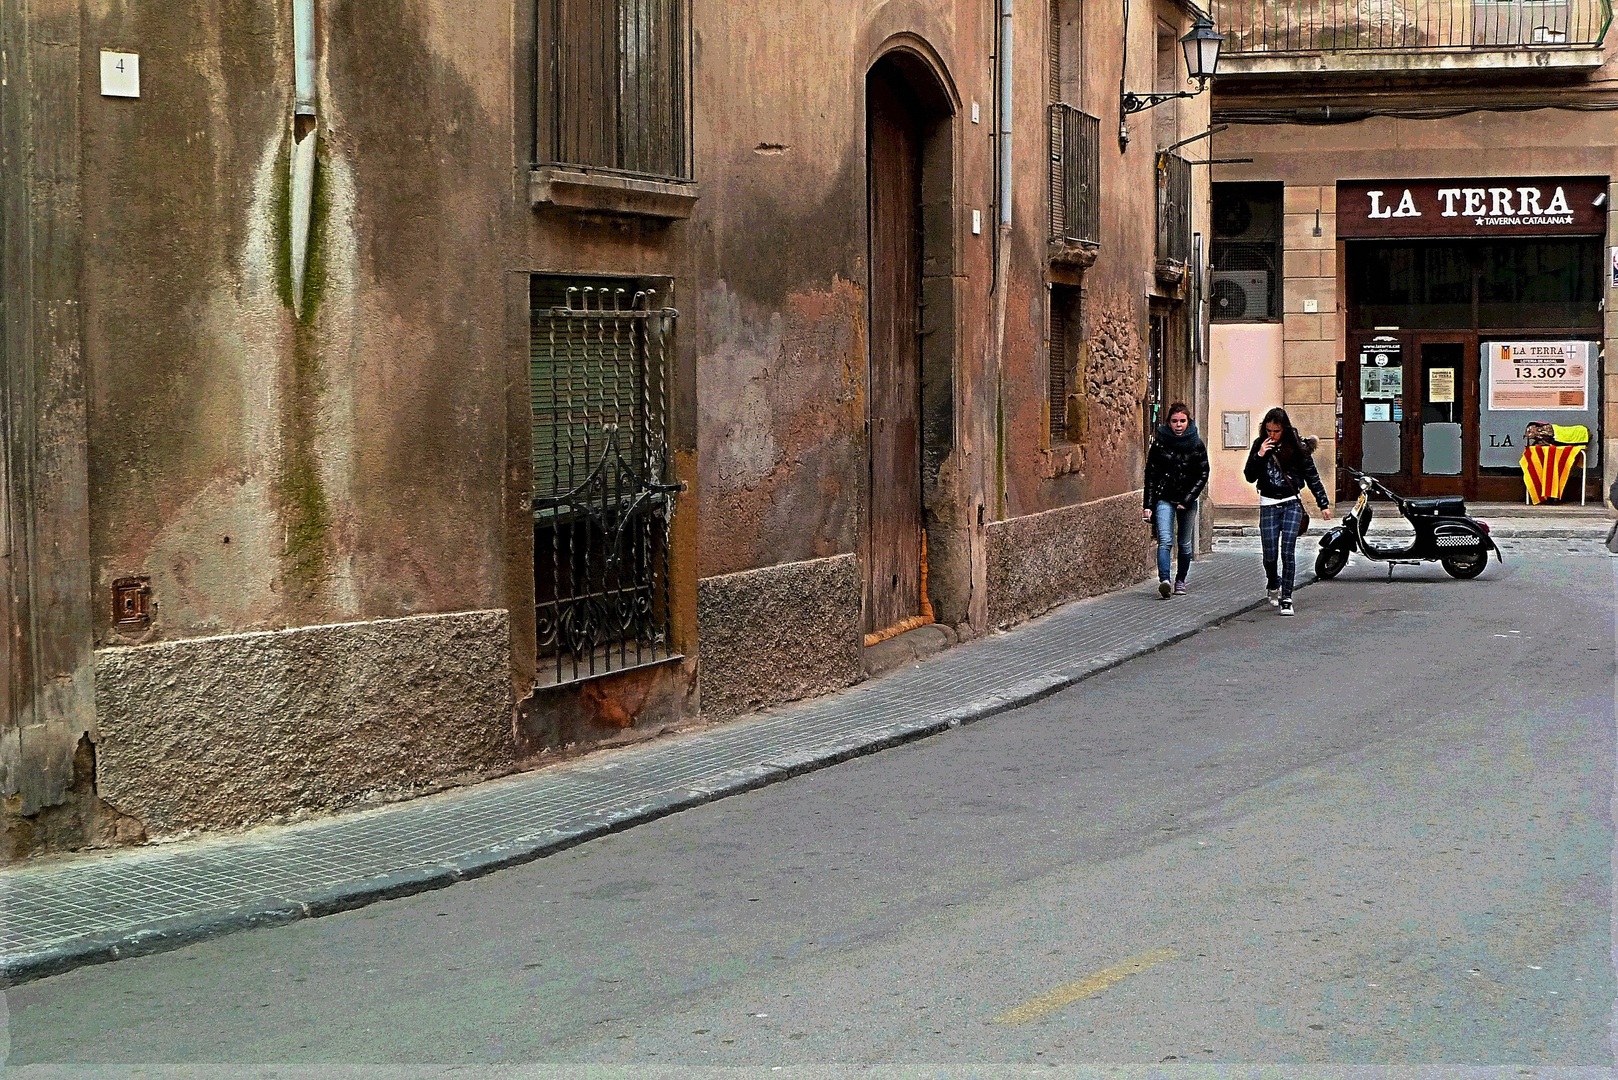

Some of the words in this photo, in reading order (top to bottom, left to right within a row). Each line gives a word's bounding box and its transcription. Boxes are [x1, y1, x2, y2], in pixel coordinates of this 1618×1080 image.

[115, 58, 125, 73] 4
[1366, 188, 1422, 219] LA
[1437, 186, 1574, 217] TERRA
[1484, 217, 1521, 226] TAVERNA
[1522, 216, 1565, 225] CATALANA
[1512, 346, 1526, 355] LA
[1530, 346, 1565, 355] TERRA
[1514, 367, 1567, 379] 13.309
[1488, 433, 1514, 448] LA
